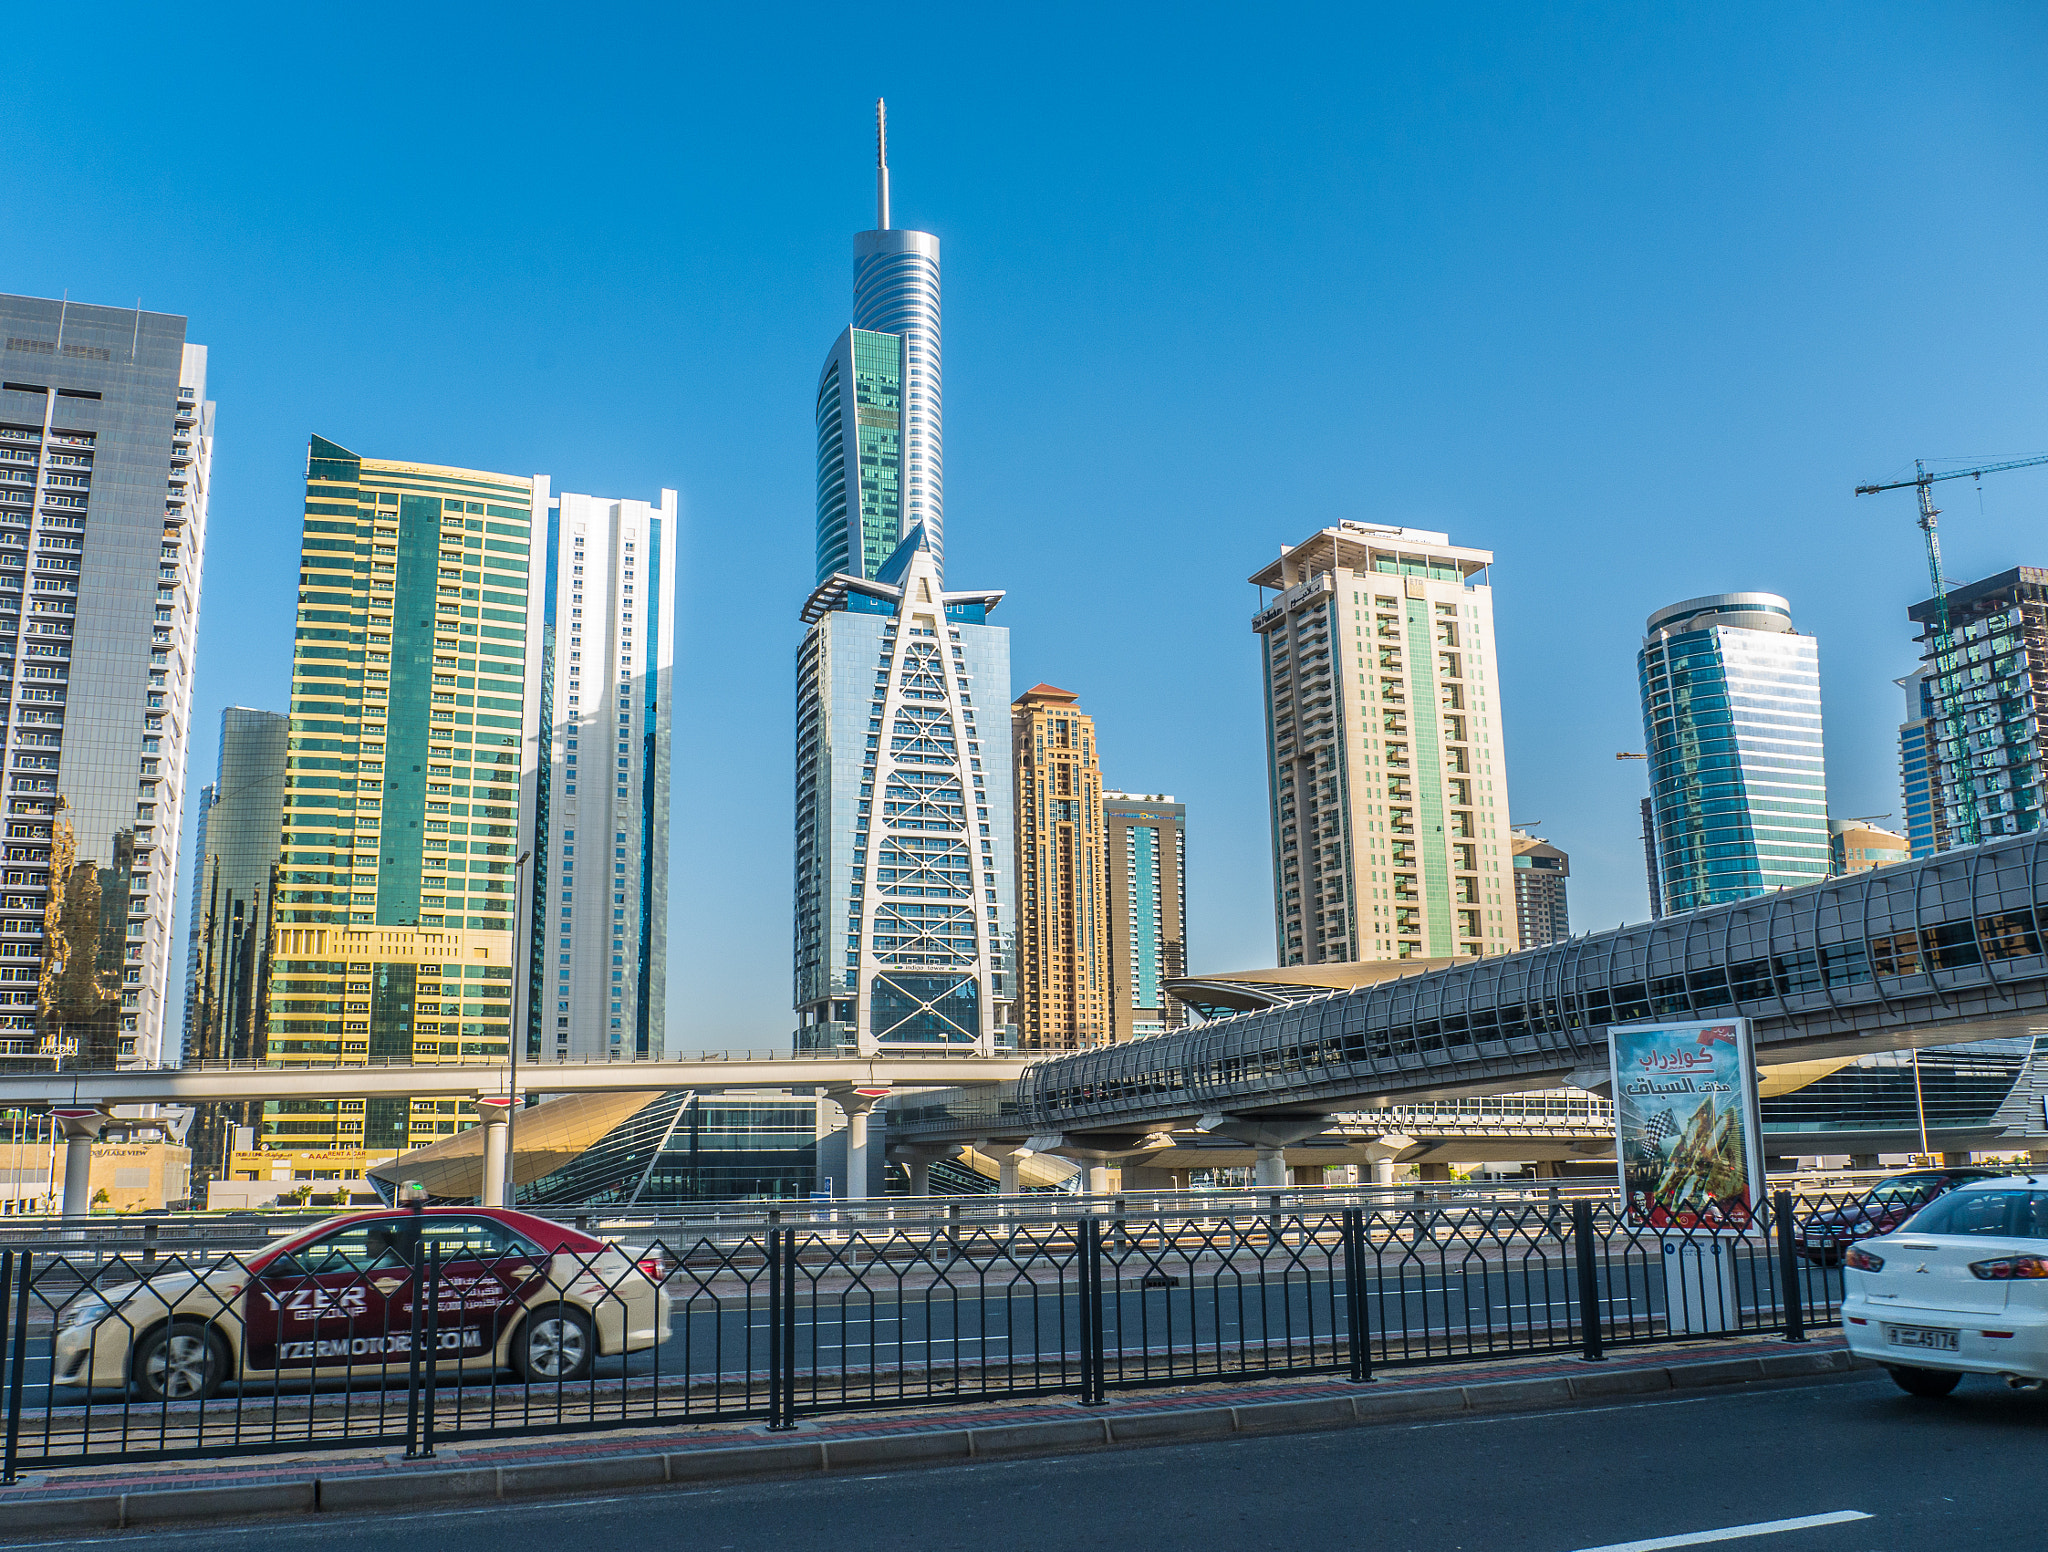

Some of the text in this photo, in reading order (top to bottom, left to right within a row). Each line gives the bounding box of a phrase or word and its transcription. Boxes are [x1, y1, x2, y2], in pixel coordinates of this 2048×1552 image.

[1639, 1047, 1713, 1071] كوادراب
[1626, 1077, 1696, 1100] السباق
[260, 1286, 366, 1311] YZER
[275, 1331, 481, 1359] YZERMOTOR.OM
